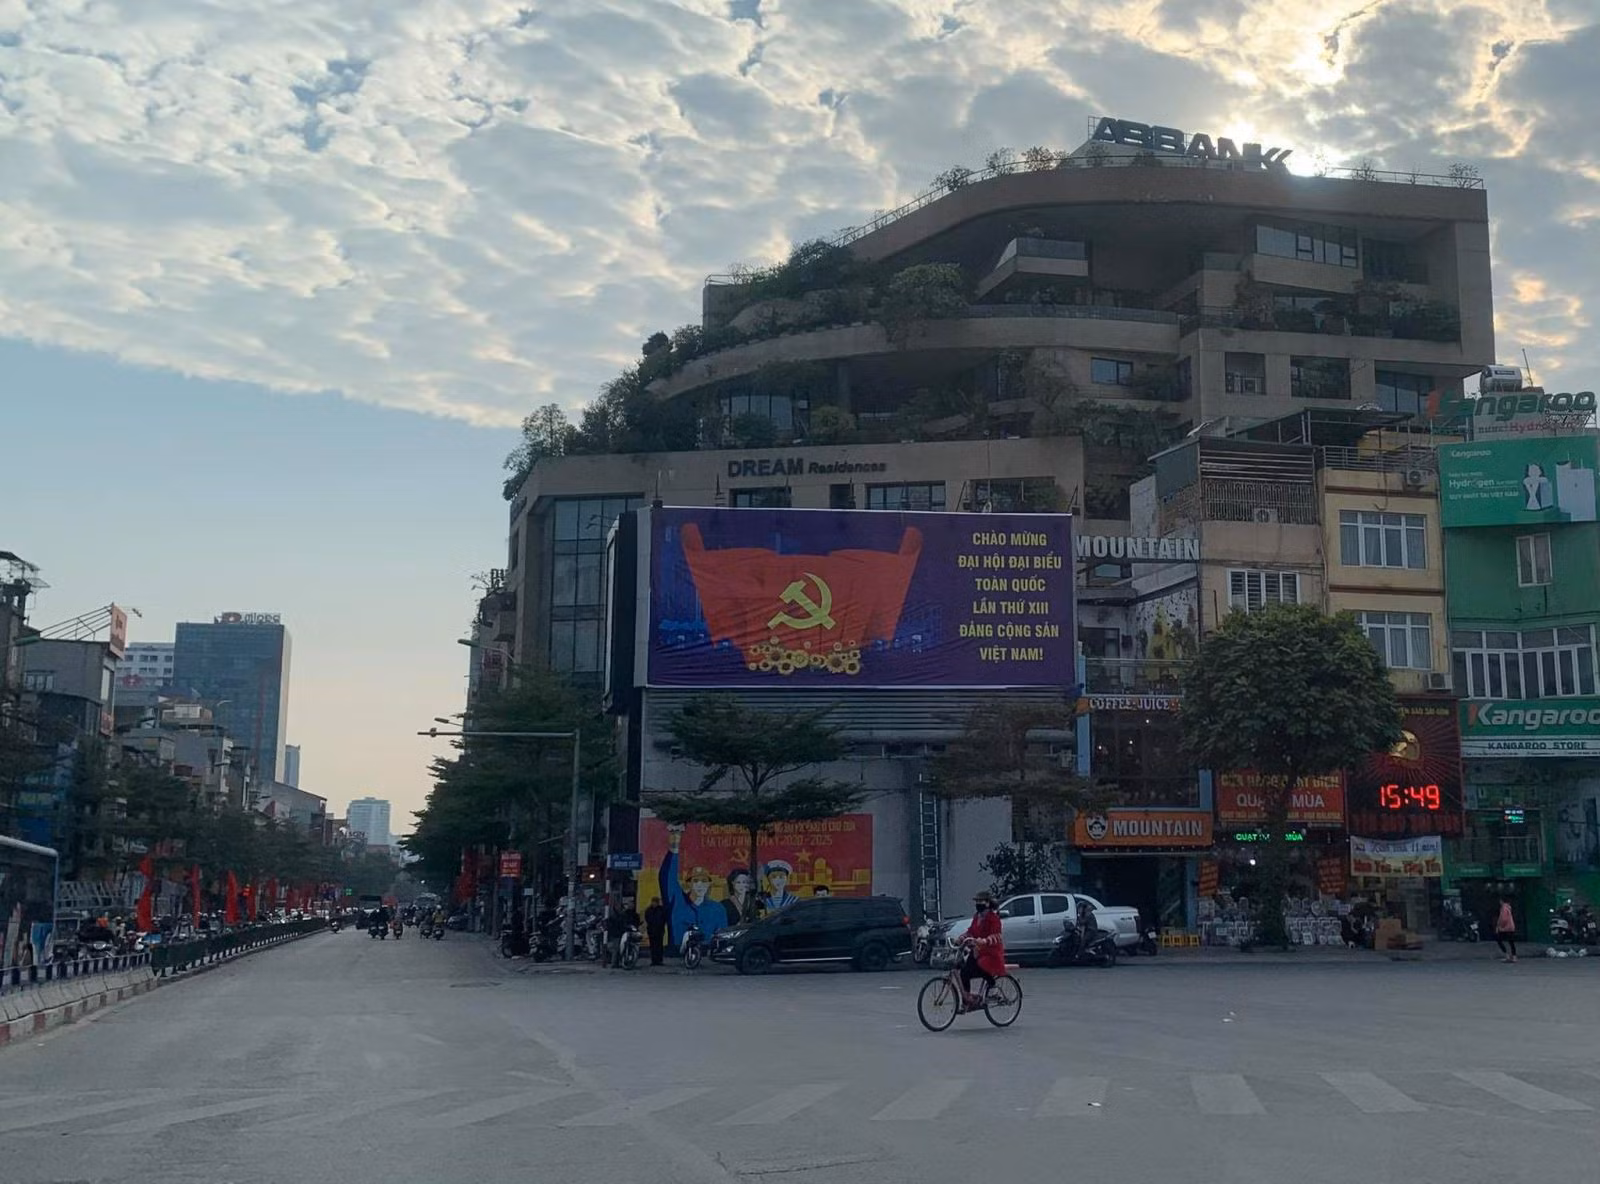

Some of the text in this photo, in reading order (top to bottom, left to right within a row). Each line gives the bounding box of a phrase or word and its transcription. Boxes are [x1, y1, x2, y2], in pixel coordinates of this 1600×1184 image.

[1092, 116, 1293, 174] ABBANK
[728, 458, 887, 477] DREAM Residences
[973, 529, 1047, 546] CHÀO MỪNG
[1076, 535, 1200, 560] MOUNTAIN
[958, 551, 1062, 571] ĐẠI HỘI ĐẠI BIỂU
[975, 574, 1046, 592] TOÀN QUỐC
[973, 596, 1049, 614] LẦN THỨ XIII
[959, 620, 1059, 640] ĐẢNG CỘNG SẢN
[979, 645, 1043, 663] VIỆT NAM!
[1090, 698, 1170, 710] COFFEE JUICE
[1468, 703, 1600, 730] Kangaroo
[1487, 741, 1587, 750] KANGAROO STORE
[1292, 791, 1326, 808] MÙA
[1380, 784, 1440, 810] 15:49
[1113, 819, 1203, 836] MOUNTAIN
